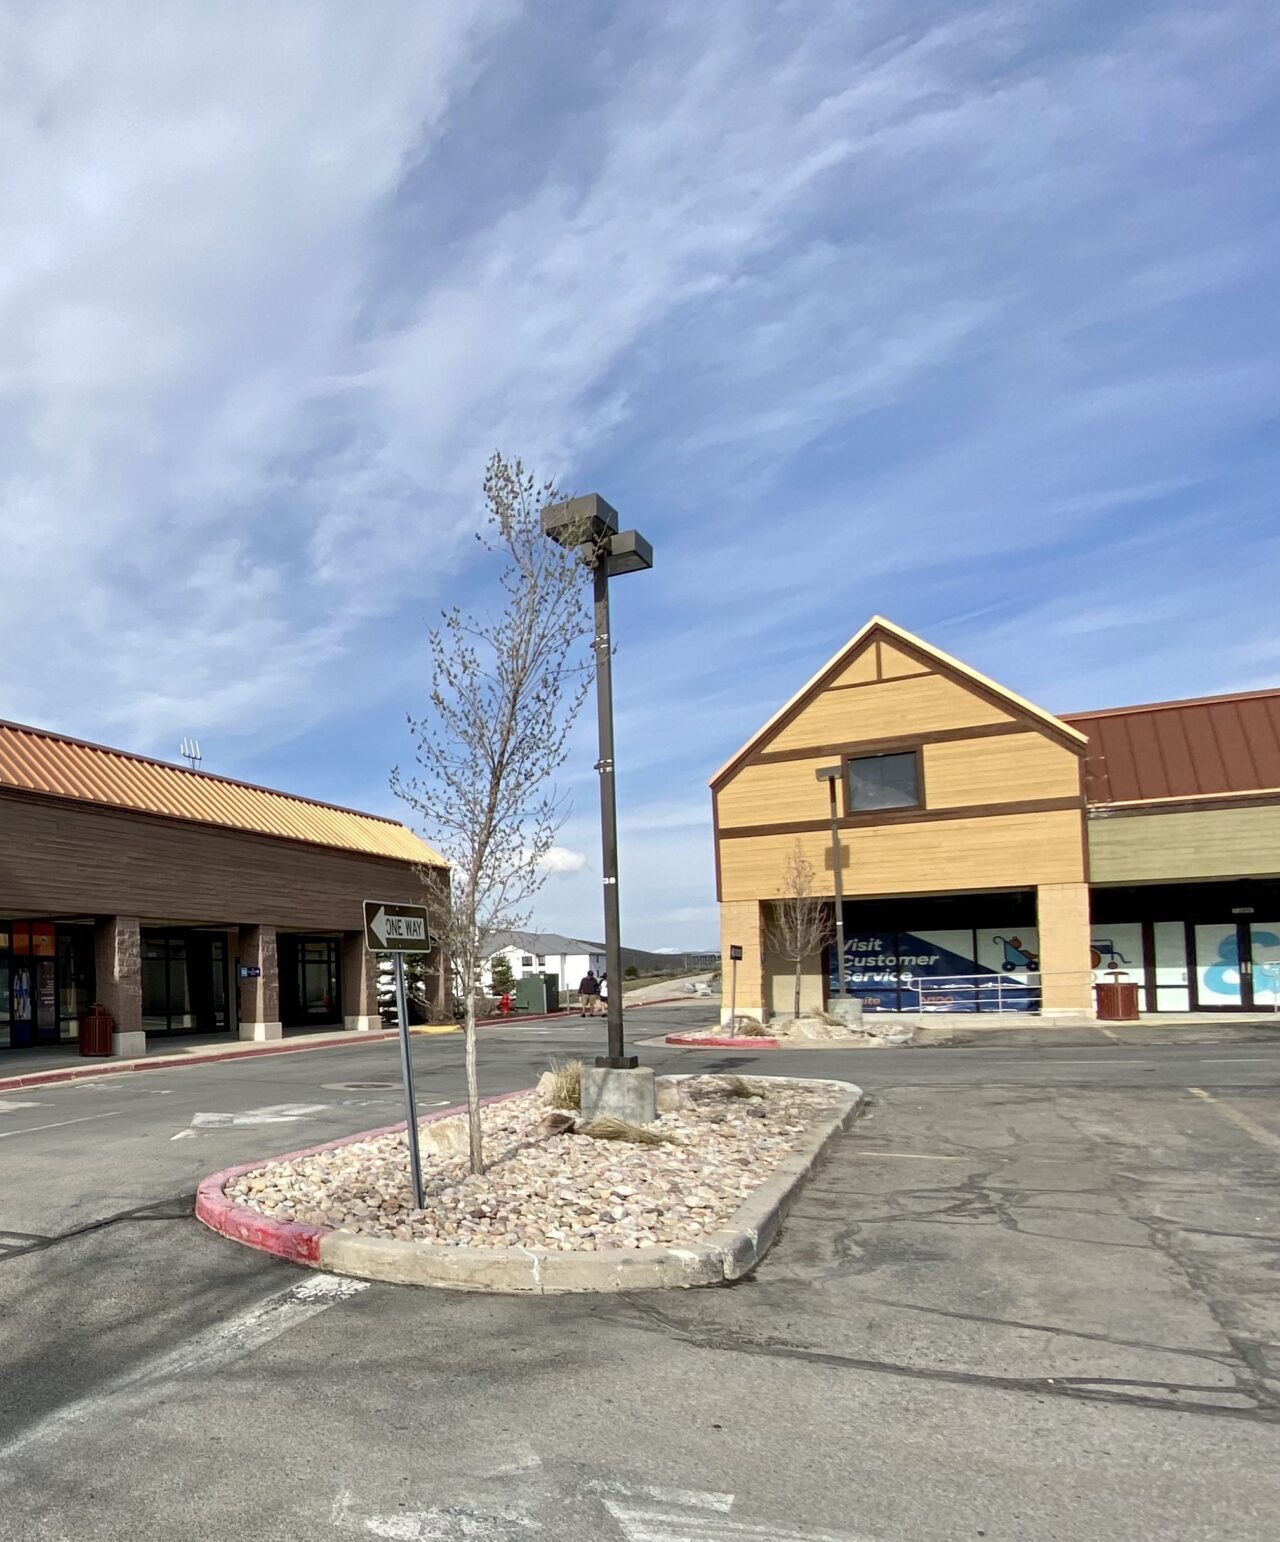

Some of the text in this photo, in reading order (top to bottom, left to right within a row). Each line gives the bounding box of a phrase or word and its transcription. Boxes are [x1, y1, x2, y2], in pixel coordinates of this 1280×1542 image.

[386, 918, 422, 937] ONE WAY
[844, 955, 939, 967] Customer
[844, 969, 913, 982] Service
